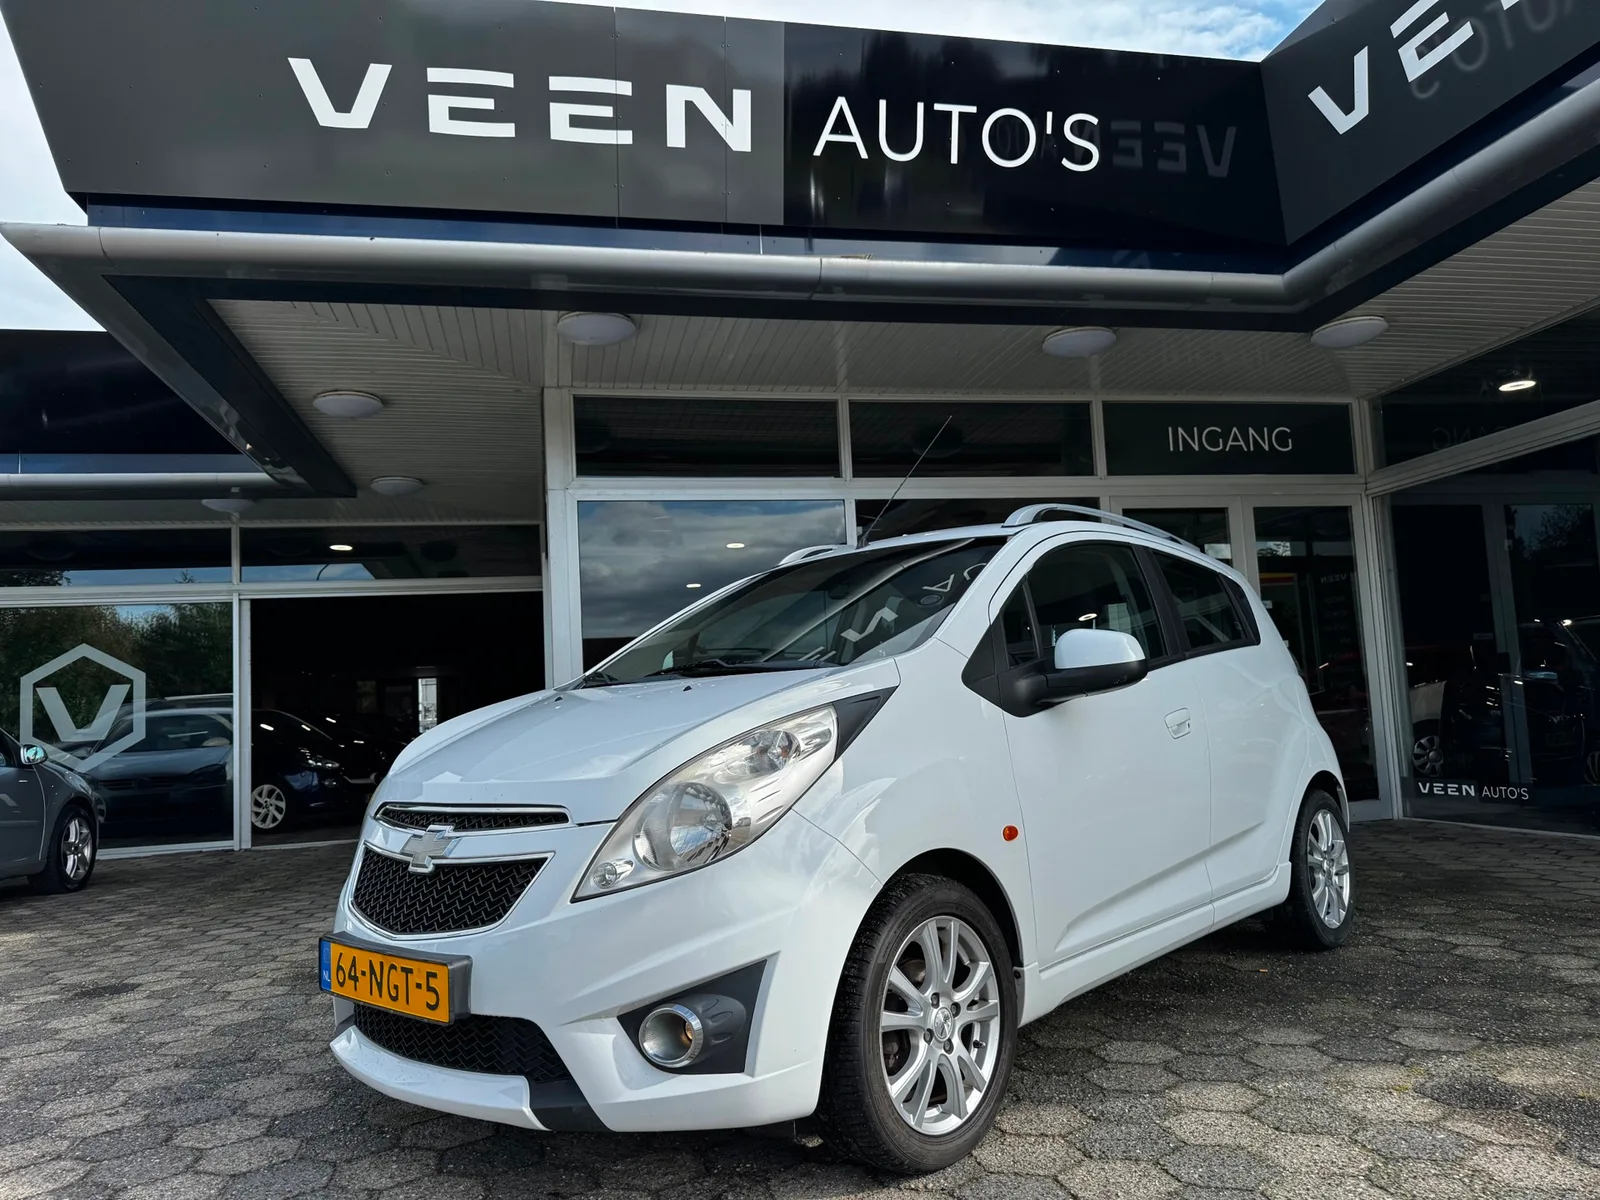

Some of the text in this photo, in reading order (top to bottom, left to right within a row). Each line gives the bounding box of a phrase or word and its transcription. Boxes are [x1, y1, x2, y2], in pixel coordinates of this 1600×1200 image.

[1308, 0, 1520, 135] VE
[287, 57, 1100, 172] VEEN AUTO'S
[1167, 426, 1294, 452] INGANG
[1417, 781, 1529, 800] VEEN AUTO'S
[336, 952, 440, 1011] 64-NGT-5
